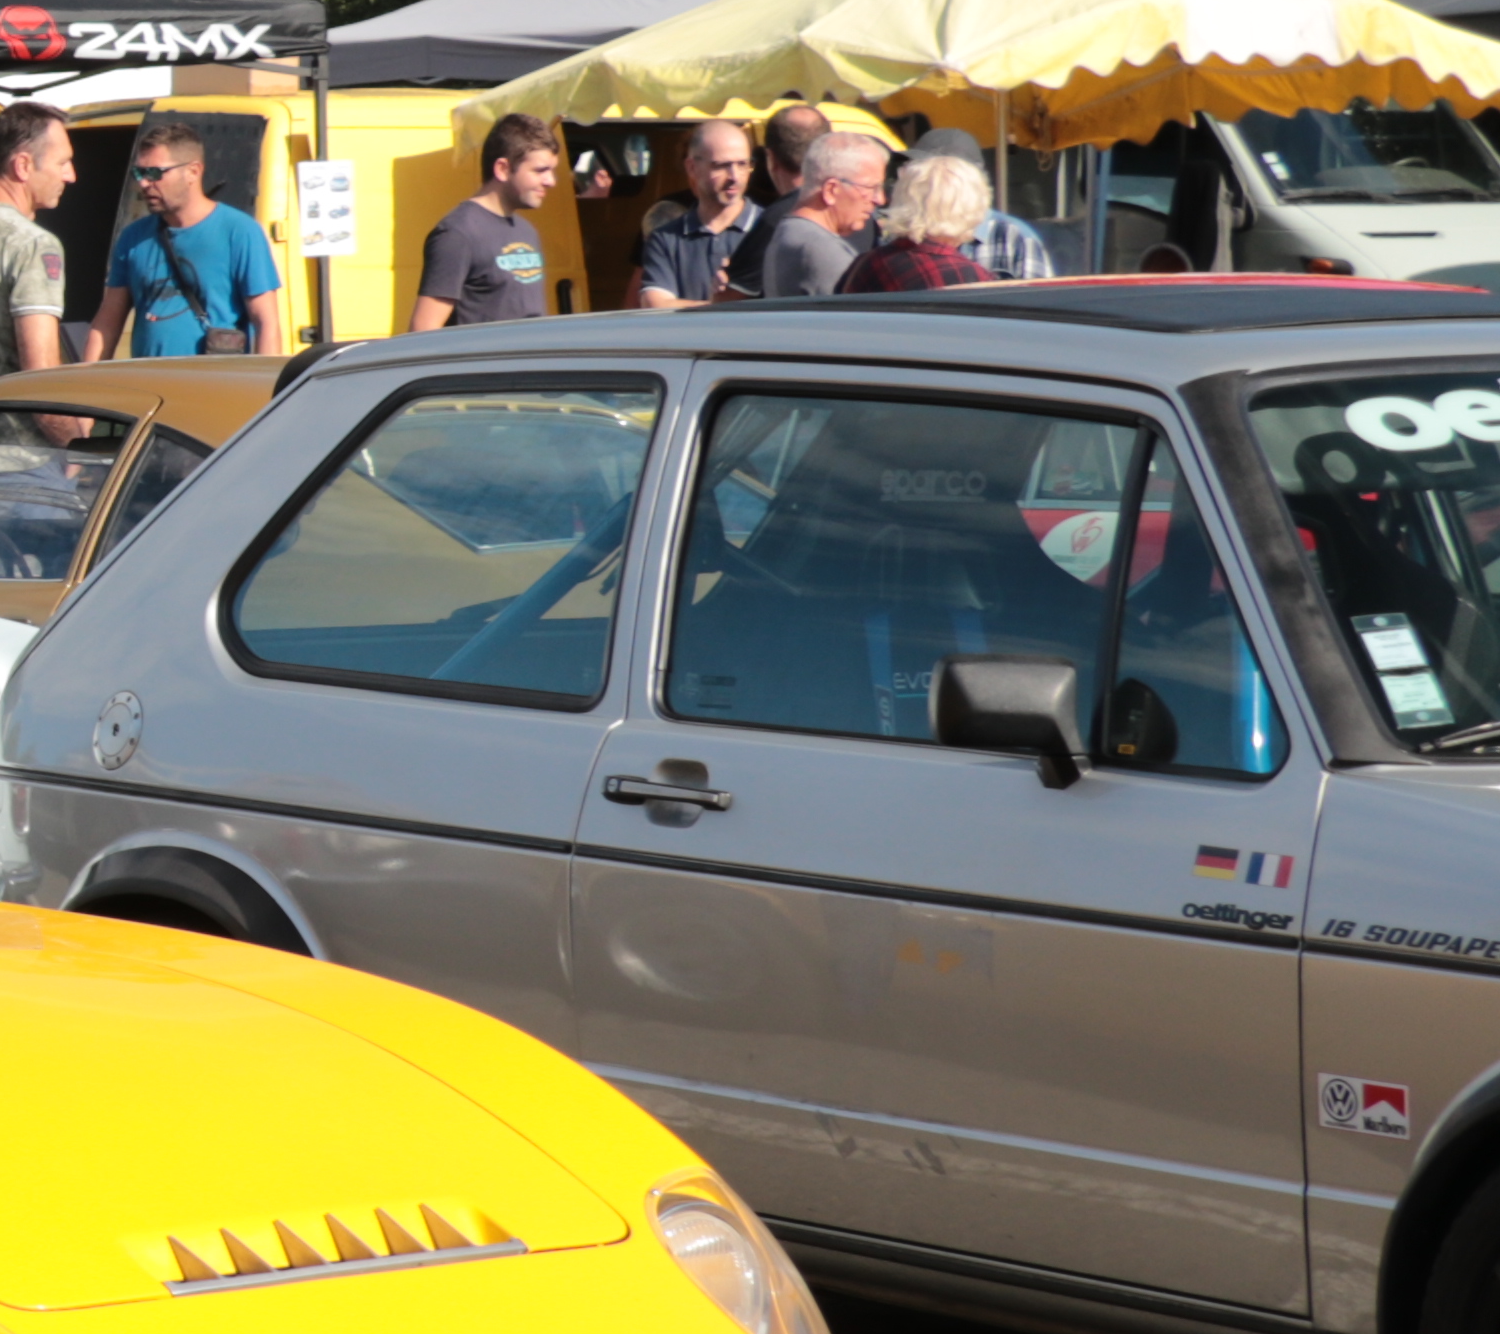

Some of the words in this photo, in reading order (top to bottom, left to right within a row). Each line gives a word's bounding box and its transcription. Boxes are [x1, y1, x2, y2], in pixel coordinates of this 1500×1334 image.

[67, 22, 276, 61] 24MX
[1181, 902, 1294, 931] oettinger
[1320, 918, 1357, 939] 16
